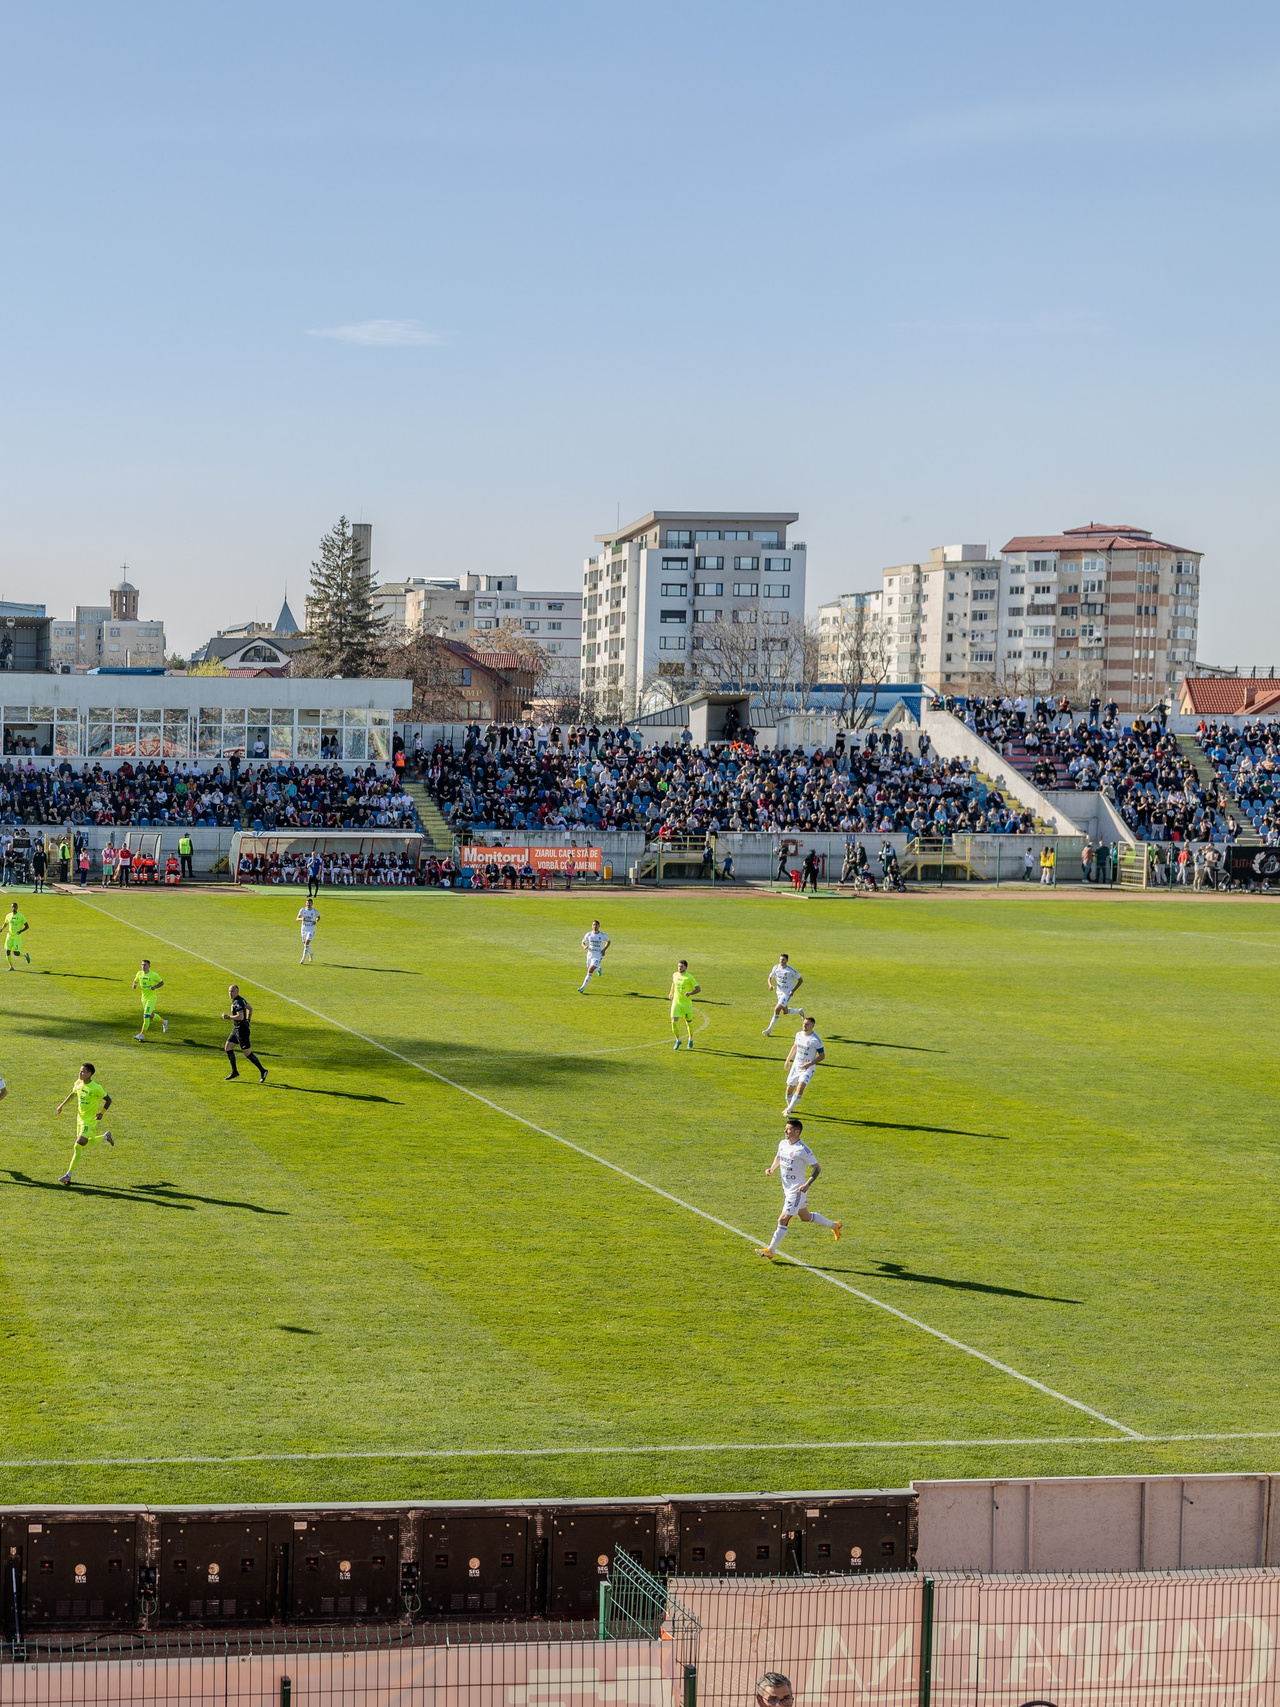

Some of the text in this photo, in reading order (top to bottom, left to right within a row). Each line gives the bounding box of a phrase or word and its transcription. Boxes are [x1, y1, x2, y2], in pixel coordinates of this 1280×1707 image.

[464, 847, 529, 863] Monitorul
[534, 849, 557, 858] ZIARUL
[589, 849, 599, 858] DE
[537, 859, 559, 870] VORBĂ
[574, 861, 597, 870] AMENII
